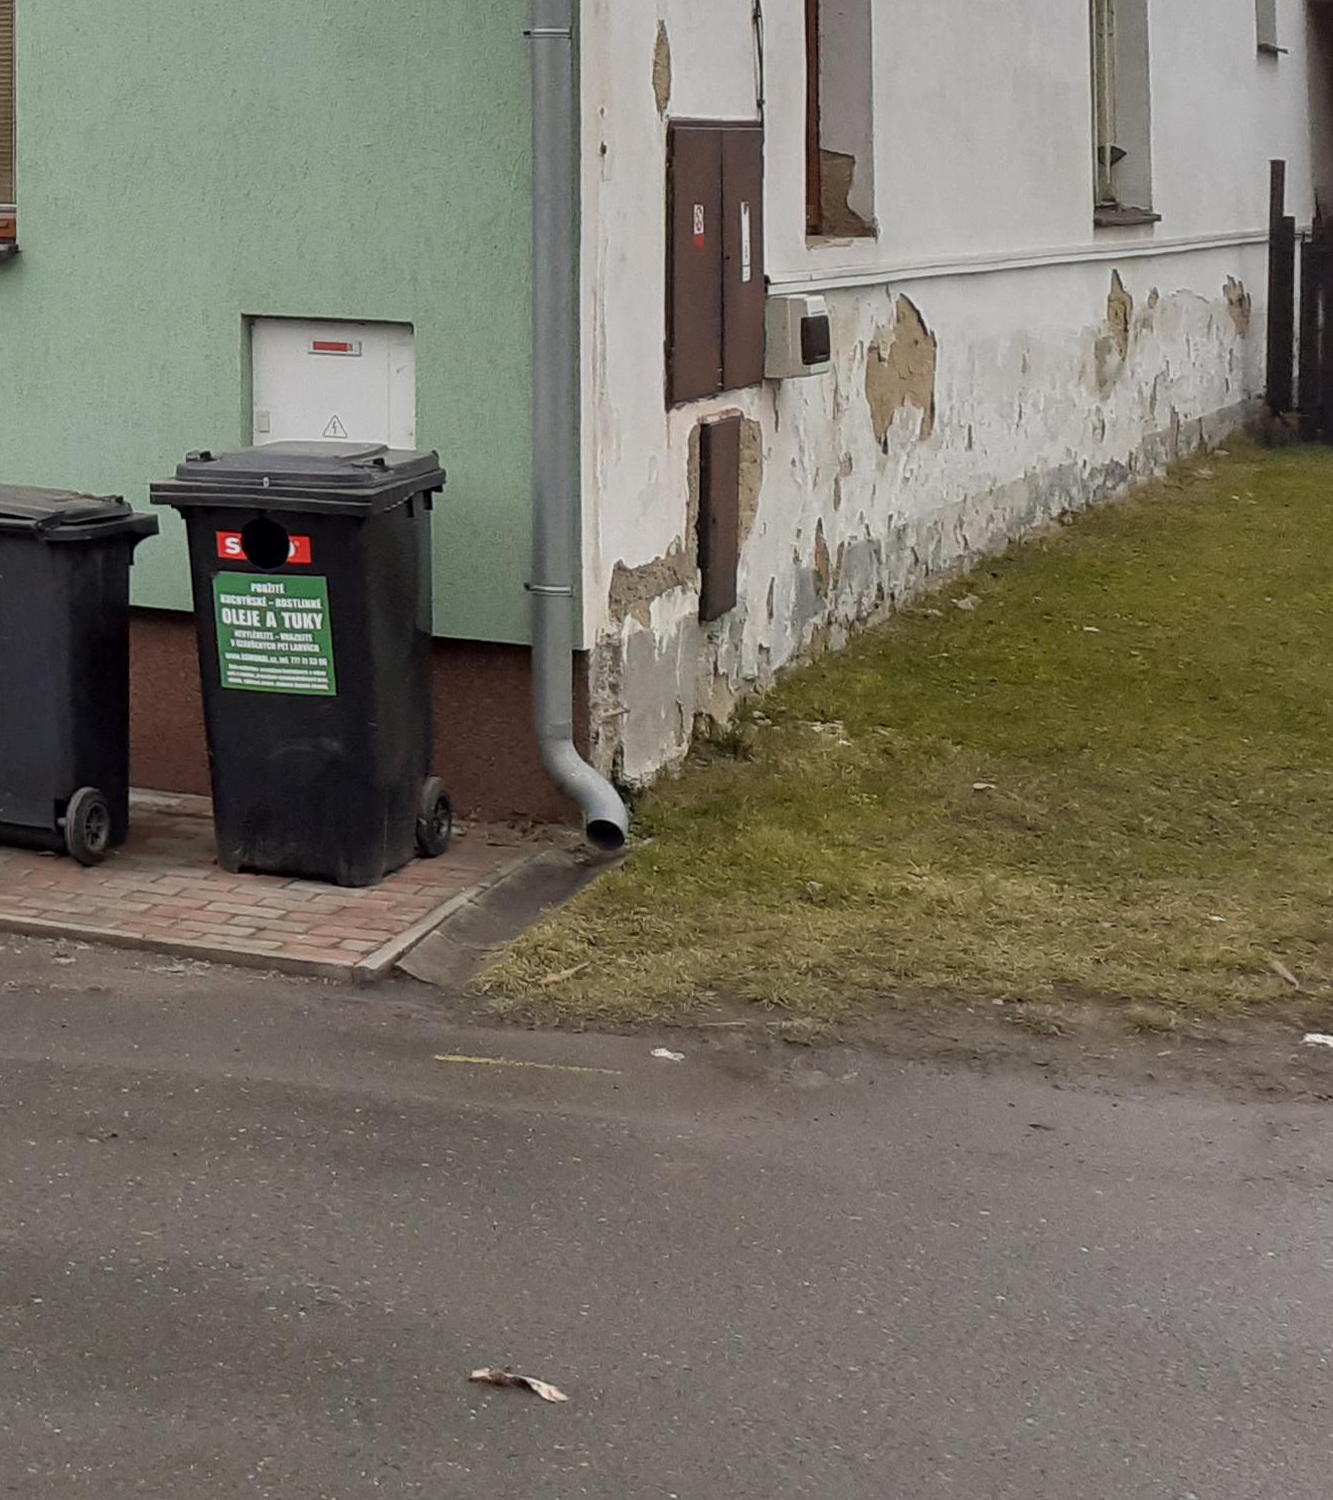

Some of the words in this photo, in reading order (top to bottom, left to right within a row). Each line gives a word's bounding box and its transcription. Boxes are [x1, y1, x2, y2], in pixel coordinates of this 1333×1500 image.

[221, 607, 262, 627] OLEJE
[265, 610, 278, 628] A
[281, 611, 323, 630] TUKY
